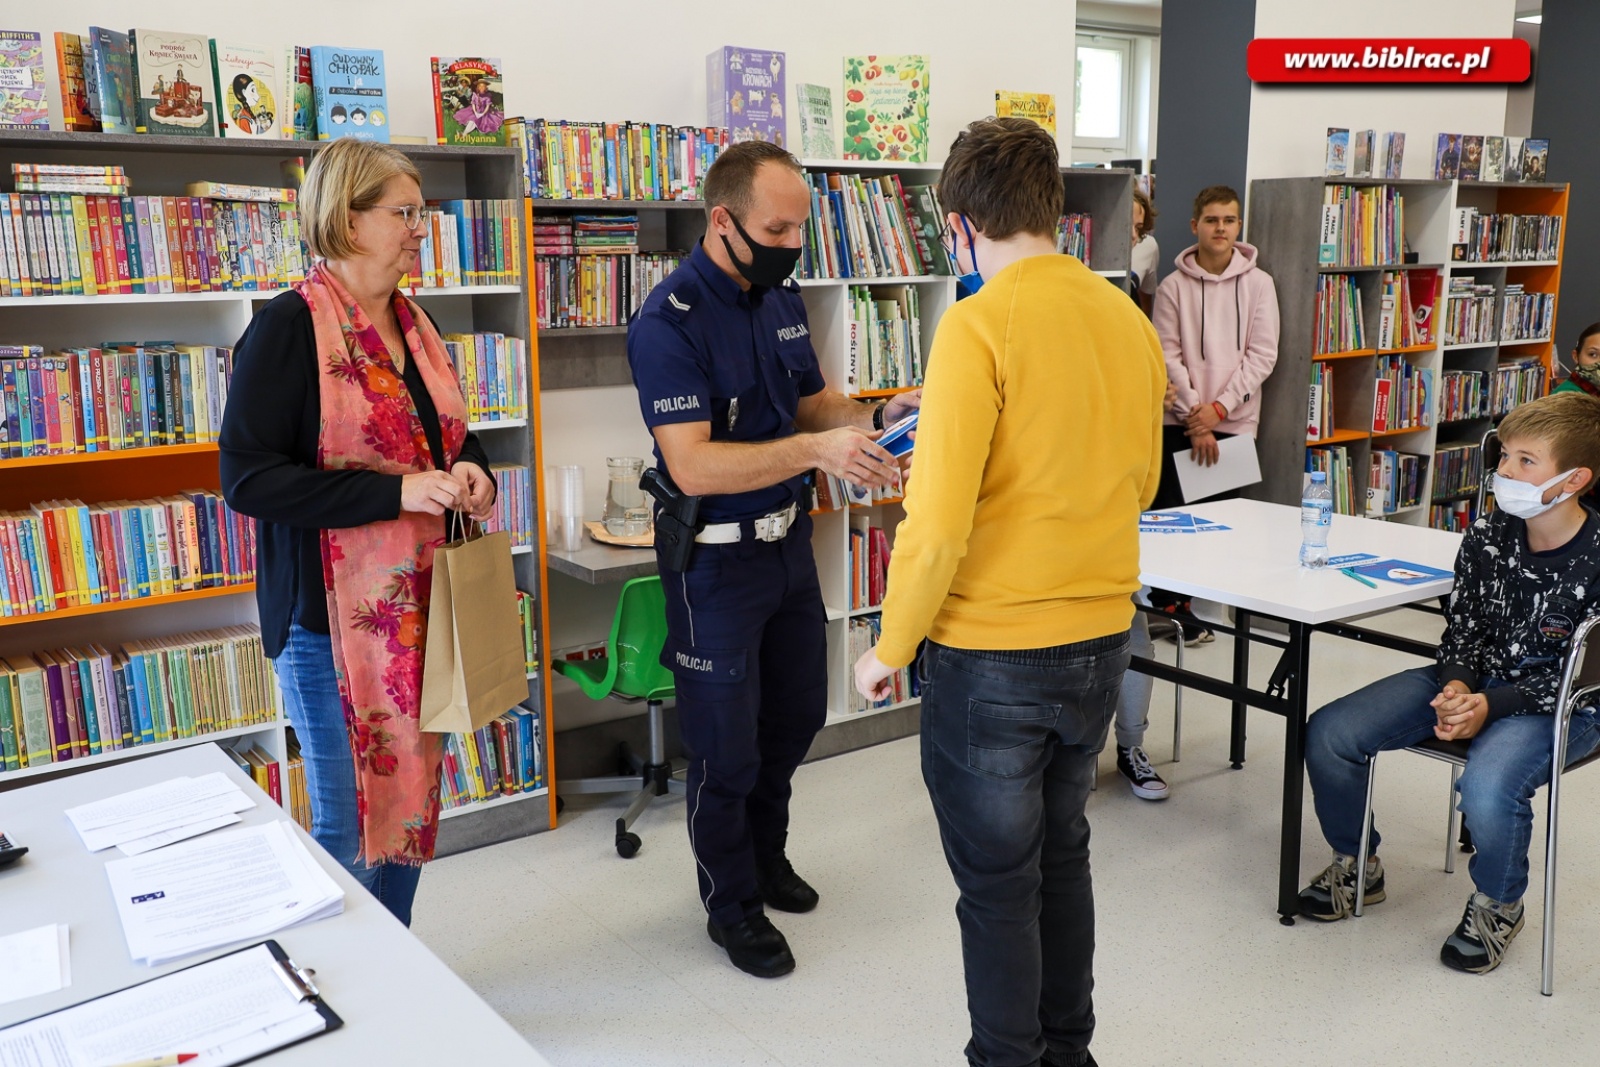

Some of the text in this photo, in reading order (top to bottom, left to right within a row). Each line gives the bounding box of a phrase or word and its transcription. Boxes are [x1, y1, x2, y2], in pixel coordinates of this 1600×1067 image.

[332, 54, 374, 65] CUDOWNY
[454, 62, 488, 70] KLASYKA
[328, 62, 380, 76] CHŁOPAK
[742, 74, 772, 88] KROWACH
[454, 134, 497, 144] Pollyanna
[776, 324, 809, 342] POLICJA
[94, 357, 100, 367] DO
[654, 395, 700, 414] POLICJA
[676, 651, 713, 672] POLICJA
